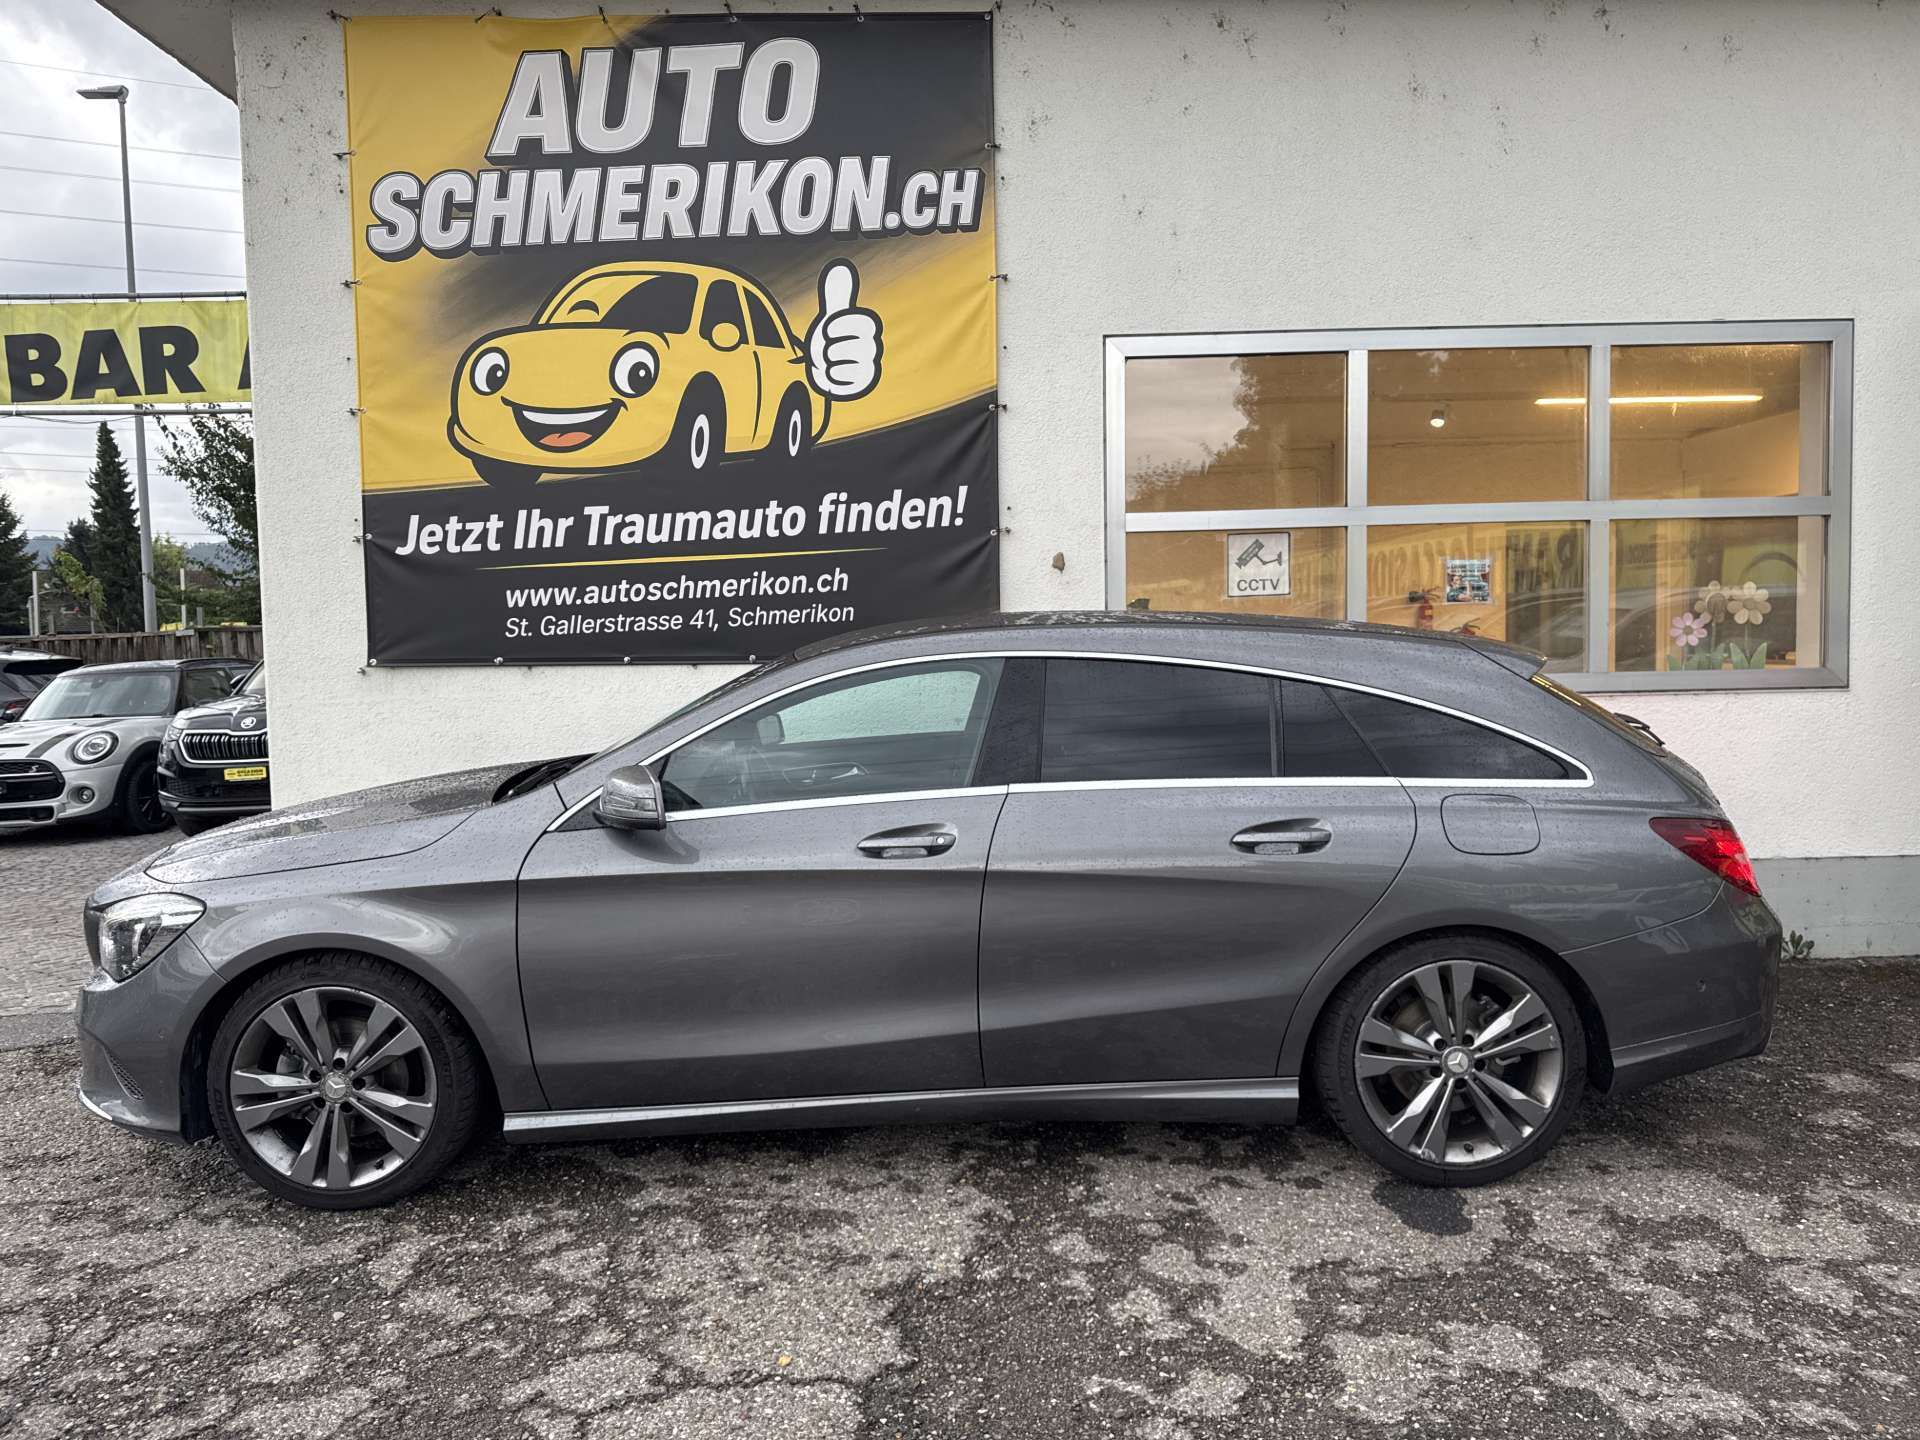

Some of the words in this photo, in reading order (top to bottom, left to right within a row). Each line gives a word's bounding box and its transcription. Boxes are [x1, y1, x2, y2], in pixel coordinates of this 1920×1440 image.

[486, 38, 823, 158] AUTO
[366, 155, 981, 254] SCHMERIKON.CH
[4, 325, 207, 403] BAR
[395, 513, 505, 557] Jetzt
[513, 508, 575, 550] Ihr
[583, 498, 807, 547] Traumauto
[818, 485, 969, 537] finden!
[505, 567, 849, 609] www.autoschmerikon.ch
[505, 616, 534, 638] St.
[540, 604, 683, 636] Gallerstrasse
[688, 608, 719, 634] 41,
[727, 603, 855, 628] Schmerikon
[1236, 578, 1281, 592] CCTV
